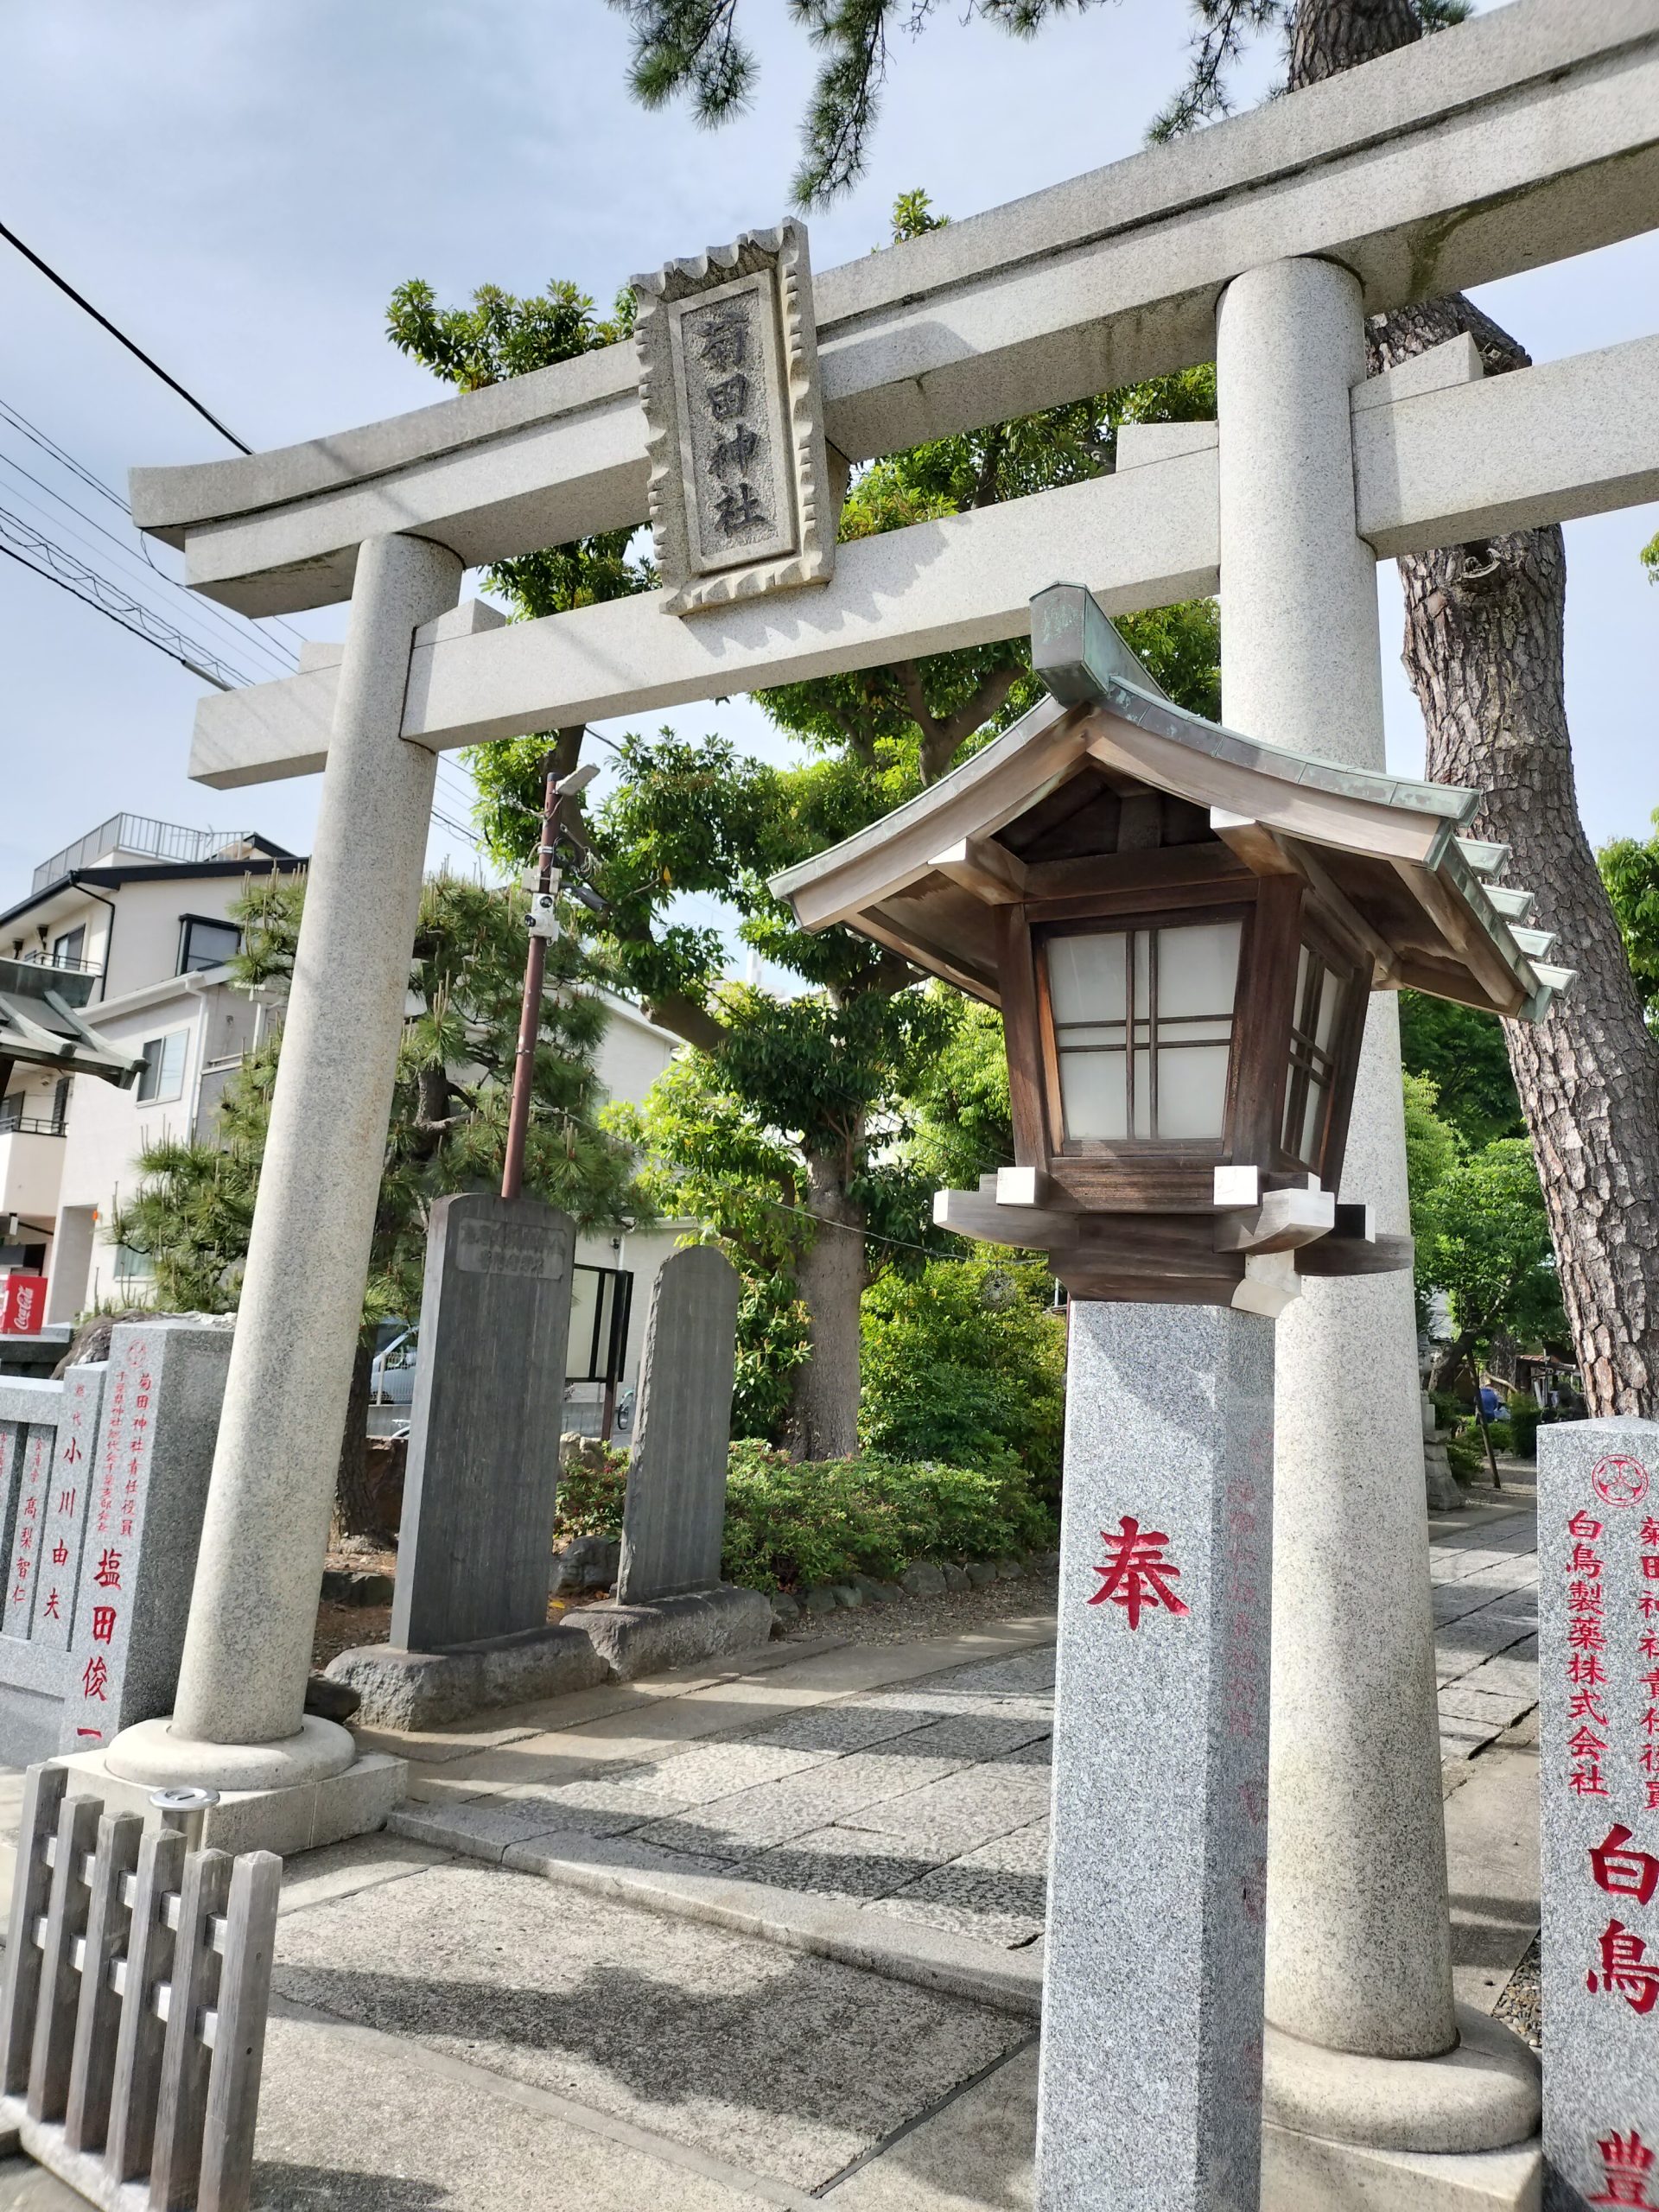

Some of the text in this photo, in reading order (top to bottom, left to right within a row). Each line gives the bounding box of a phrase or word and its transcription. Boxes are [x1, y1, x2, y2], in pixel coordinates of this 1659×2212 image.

[44, 1437, 81, 1619] 小川由夫
[1087, 1516, 1191, 1630] 奉
[76, 1548, 122, 1740] 塩田俊一
[1566, 1510, 1610, 1796] 白鳥製薬株式会社
